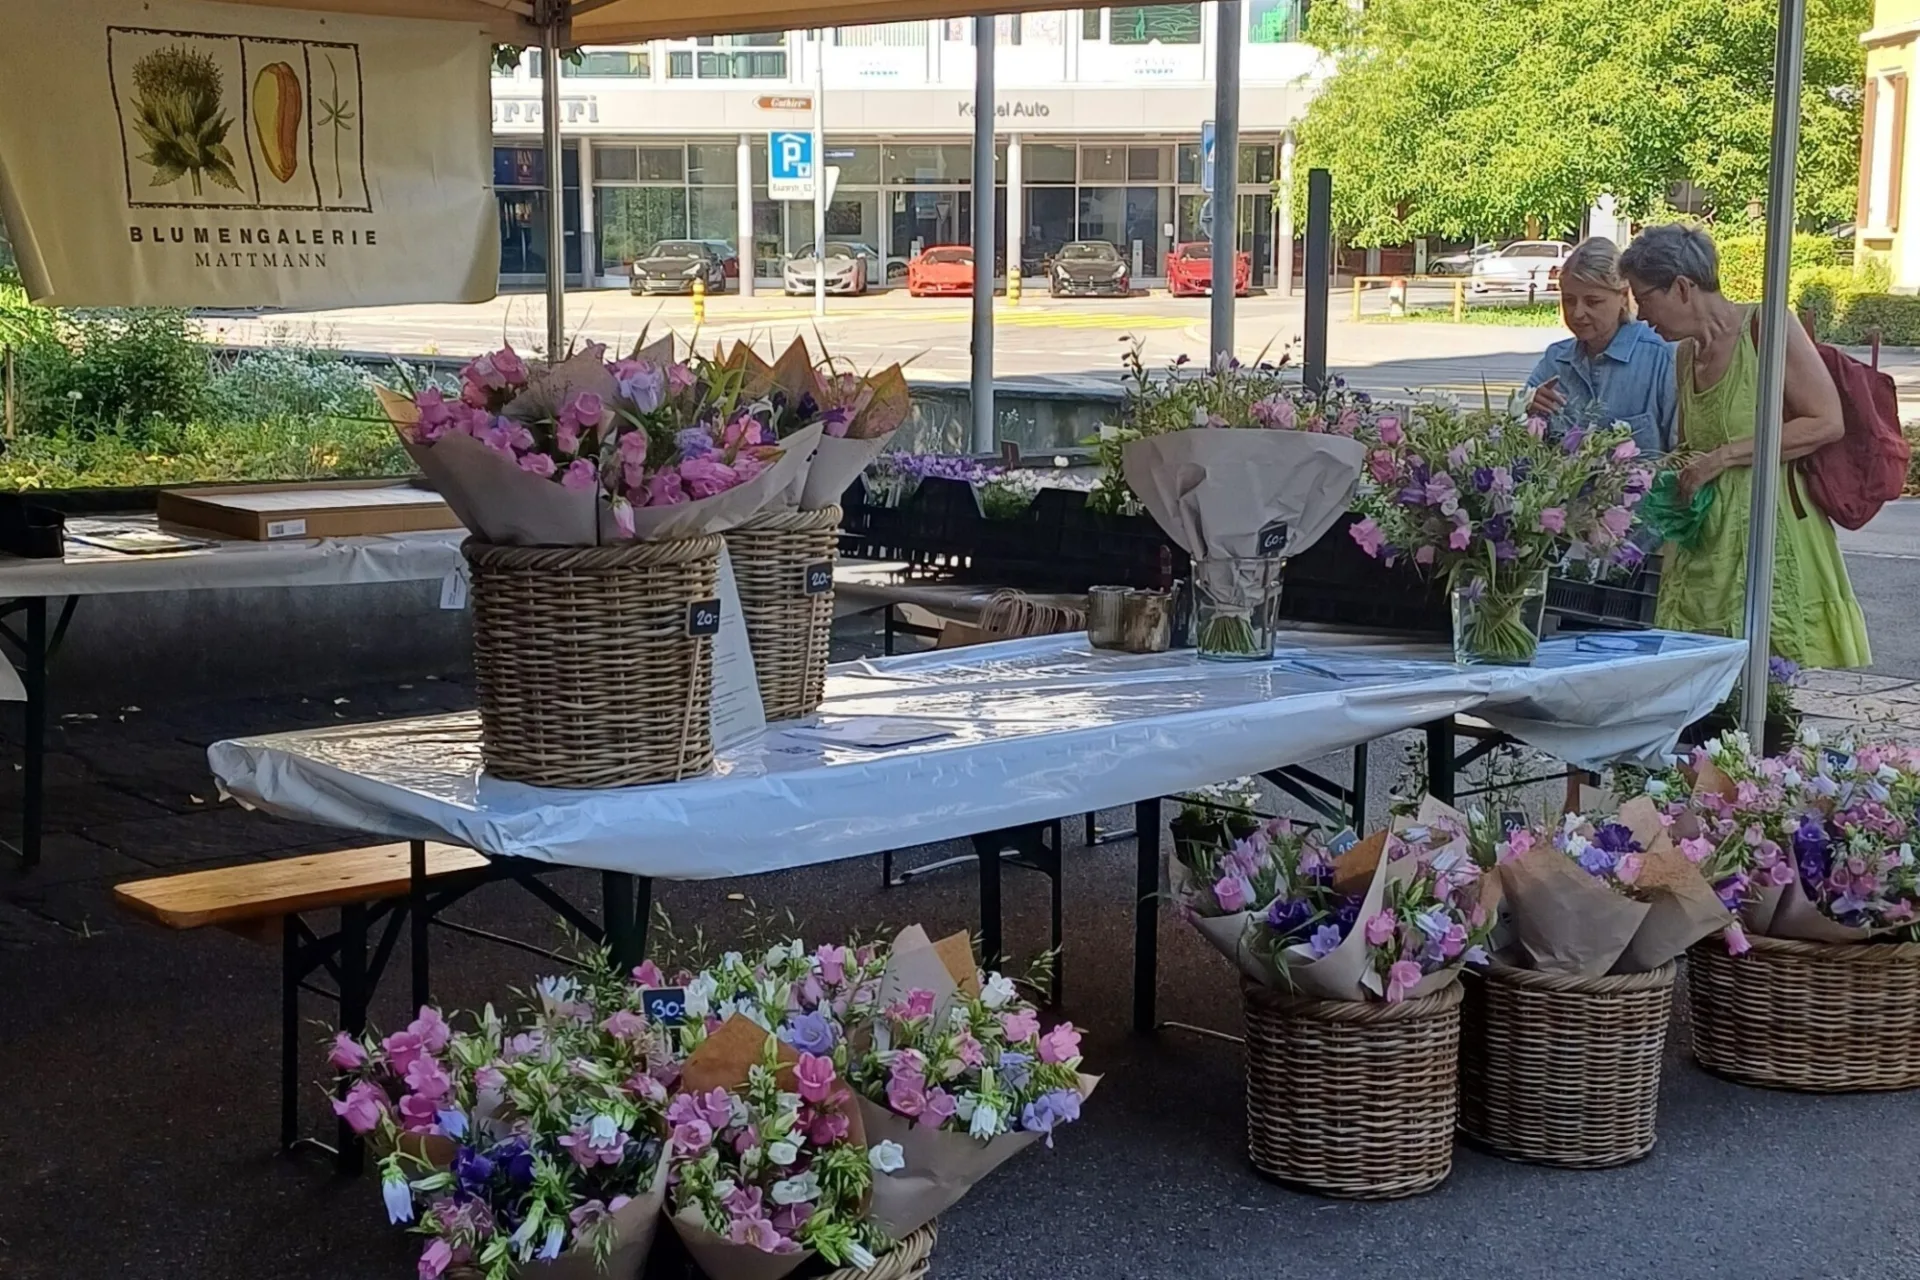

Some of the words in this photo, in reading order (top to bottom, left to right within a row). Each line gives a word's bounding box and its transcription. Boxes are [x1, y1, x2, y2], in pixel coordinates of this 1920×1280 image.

[958, 101, 1010, 117] Keel
[1013, 101, 1050, 117] Auto
[783, 142, 801, 172] P
[129, 226, 377, 246] BLUMENGALERIE
[195, 252, 327, 268] MATTMANN
